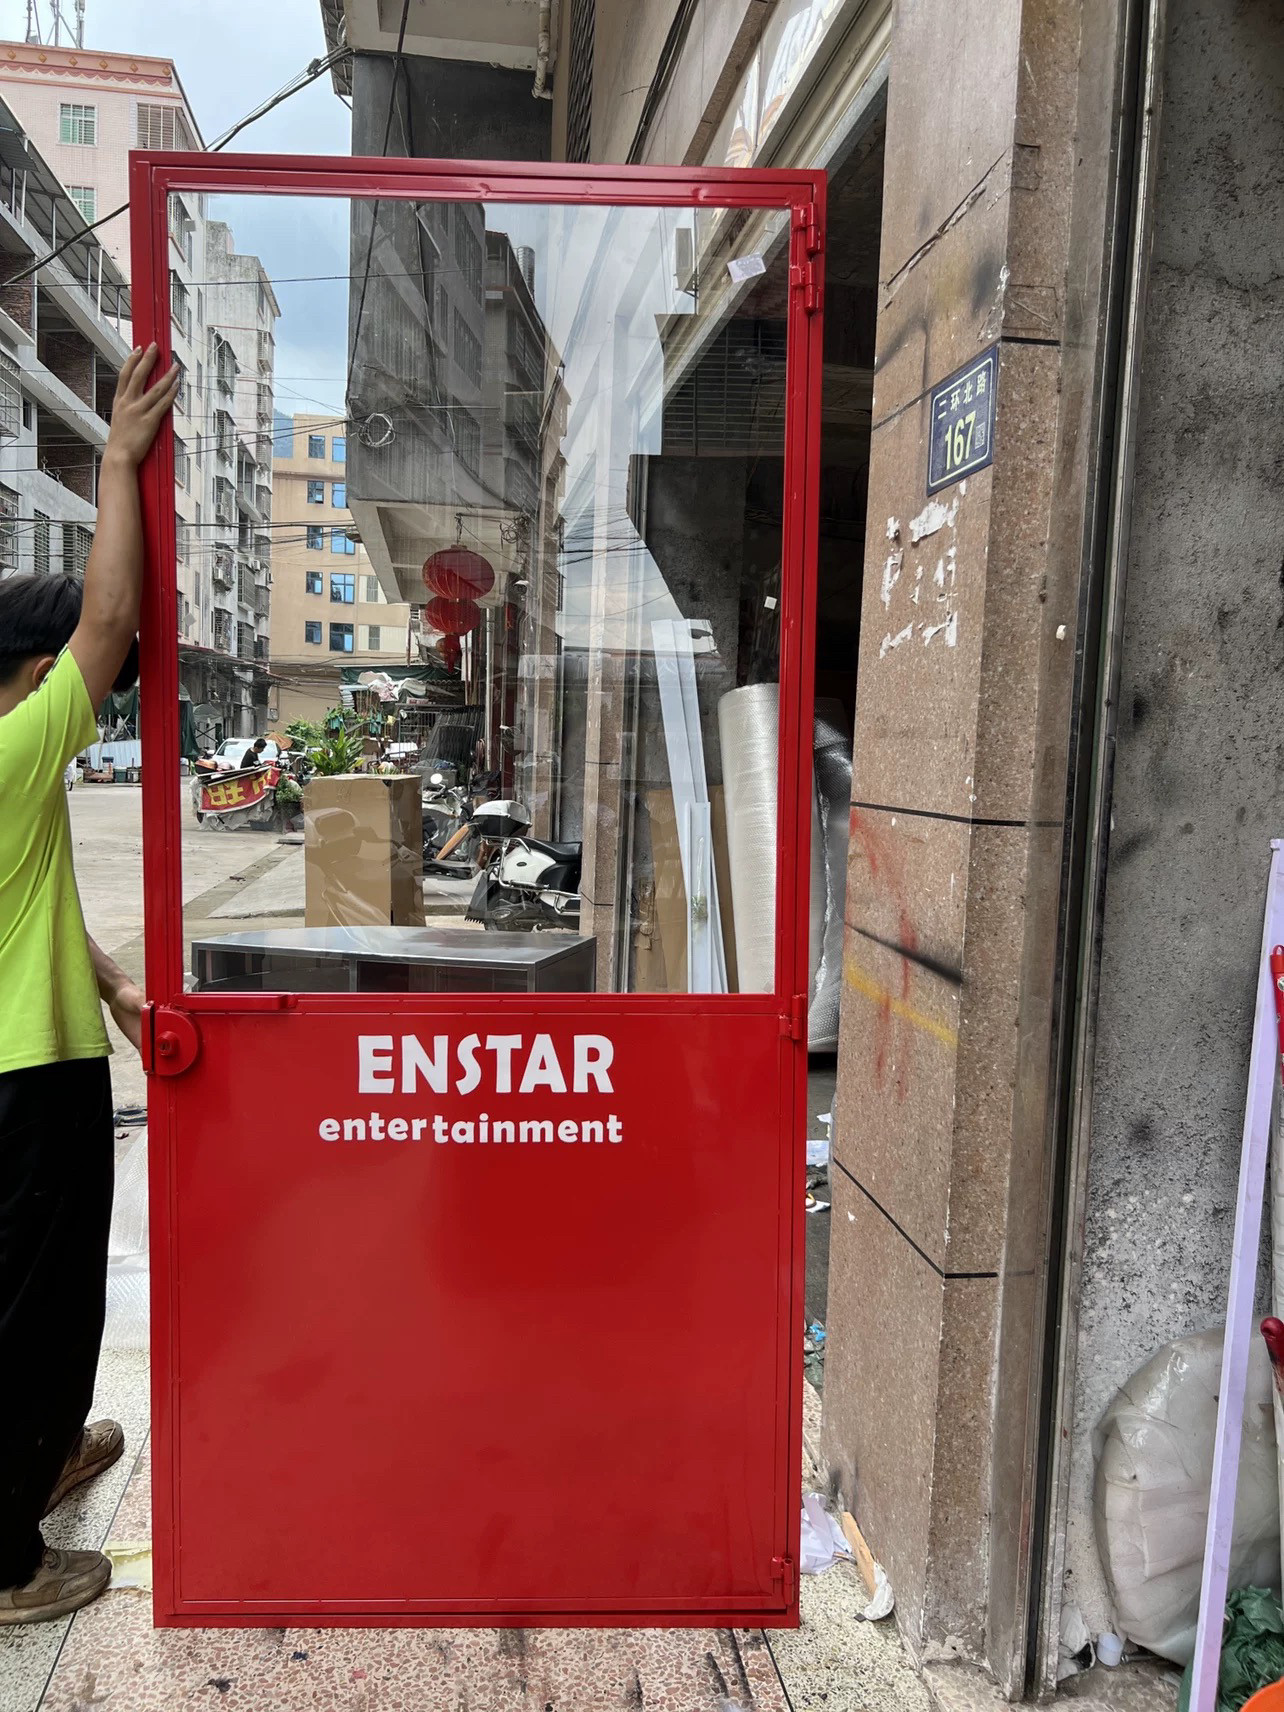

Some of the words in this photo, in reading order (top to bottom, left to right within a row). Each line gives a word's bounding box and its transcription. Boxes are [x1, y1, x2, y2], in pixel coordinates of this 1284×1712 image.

[938, 371, 987, 419] 二环北路
[945, 411, 976, 470] 167
[358, 1033, 614, 1096] ENSTAR
[319, 1112, 623, 1143] entertainment
